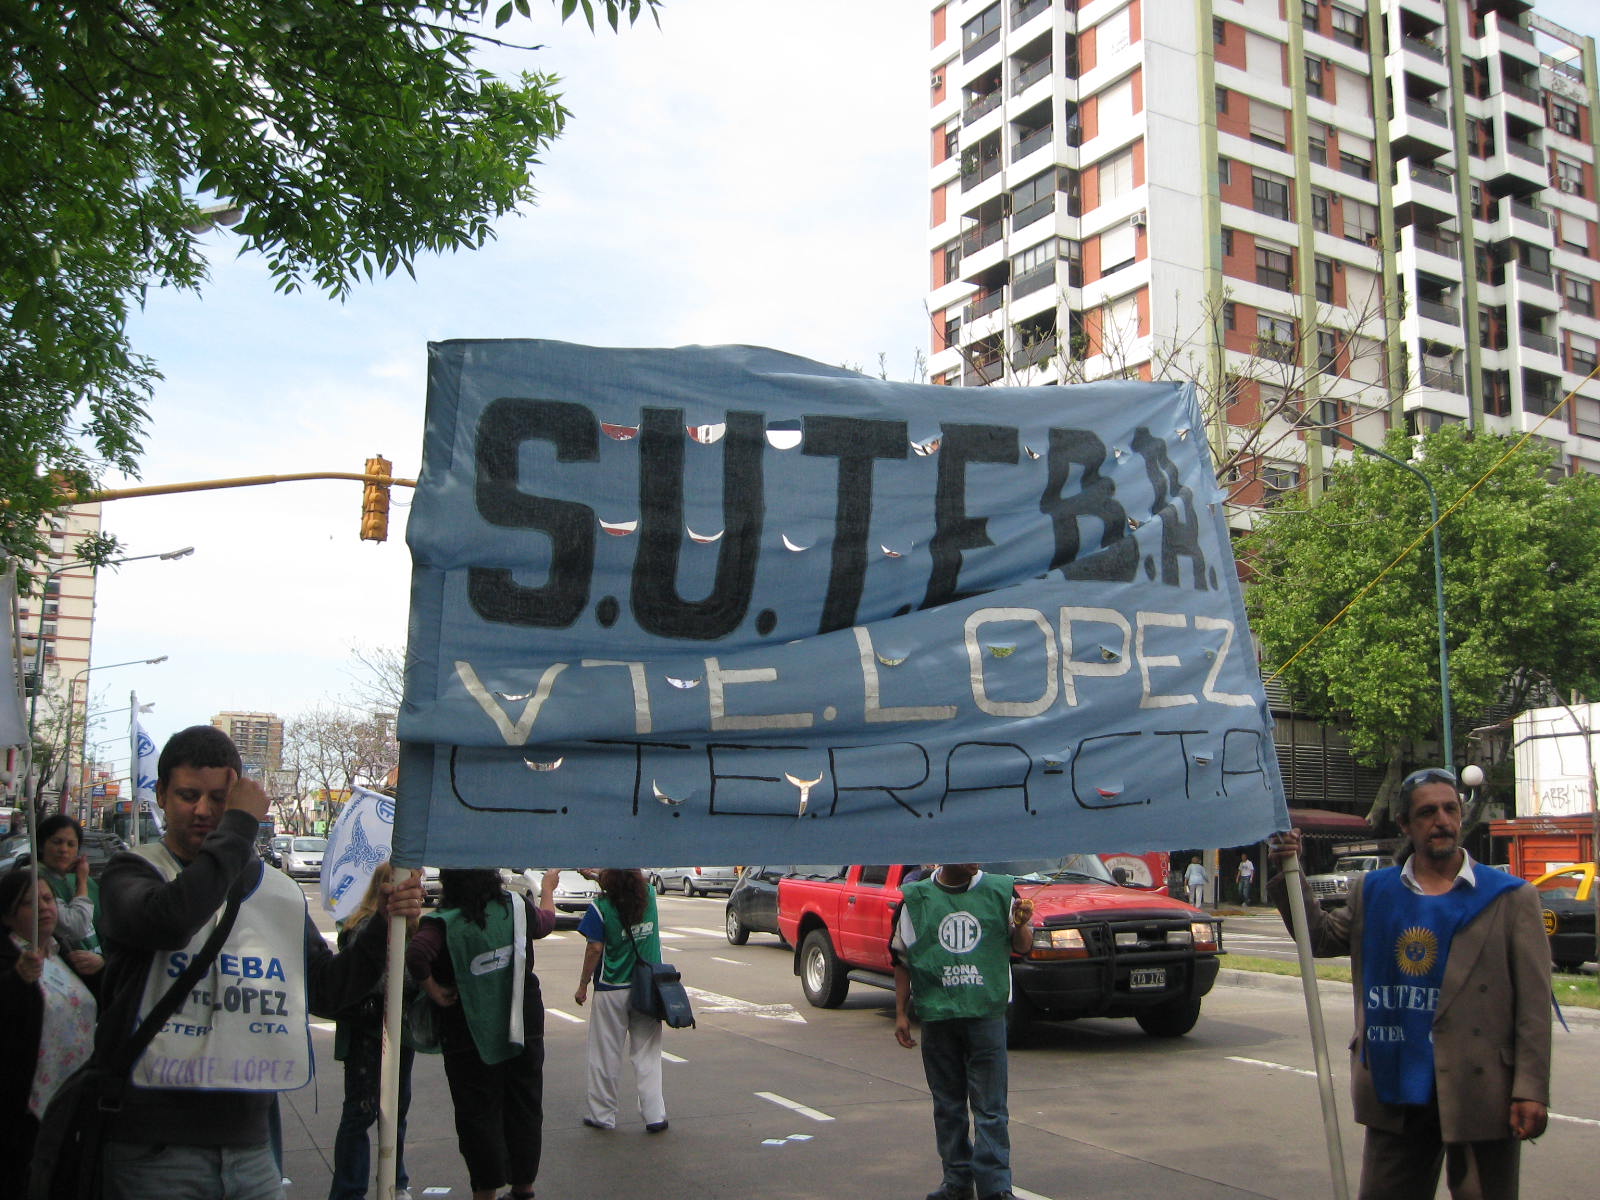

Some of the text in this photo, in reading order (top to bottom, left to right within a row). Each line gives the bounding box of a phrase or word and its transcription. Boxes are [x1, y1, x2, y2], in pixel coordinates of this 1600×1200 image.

[167, 951, 286, 982] SEBA
[943, 964, 979, 976] ZONA
[941, 974, 985, 987] NORTE
[249, 1022, 289, 1035] CTA
